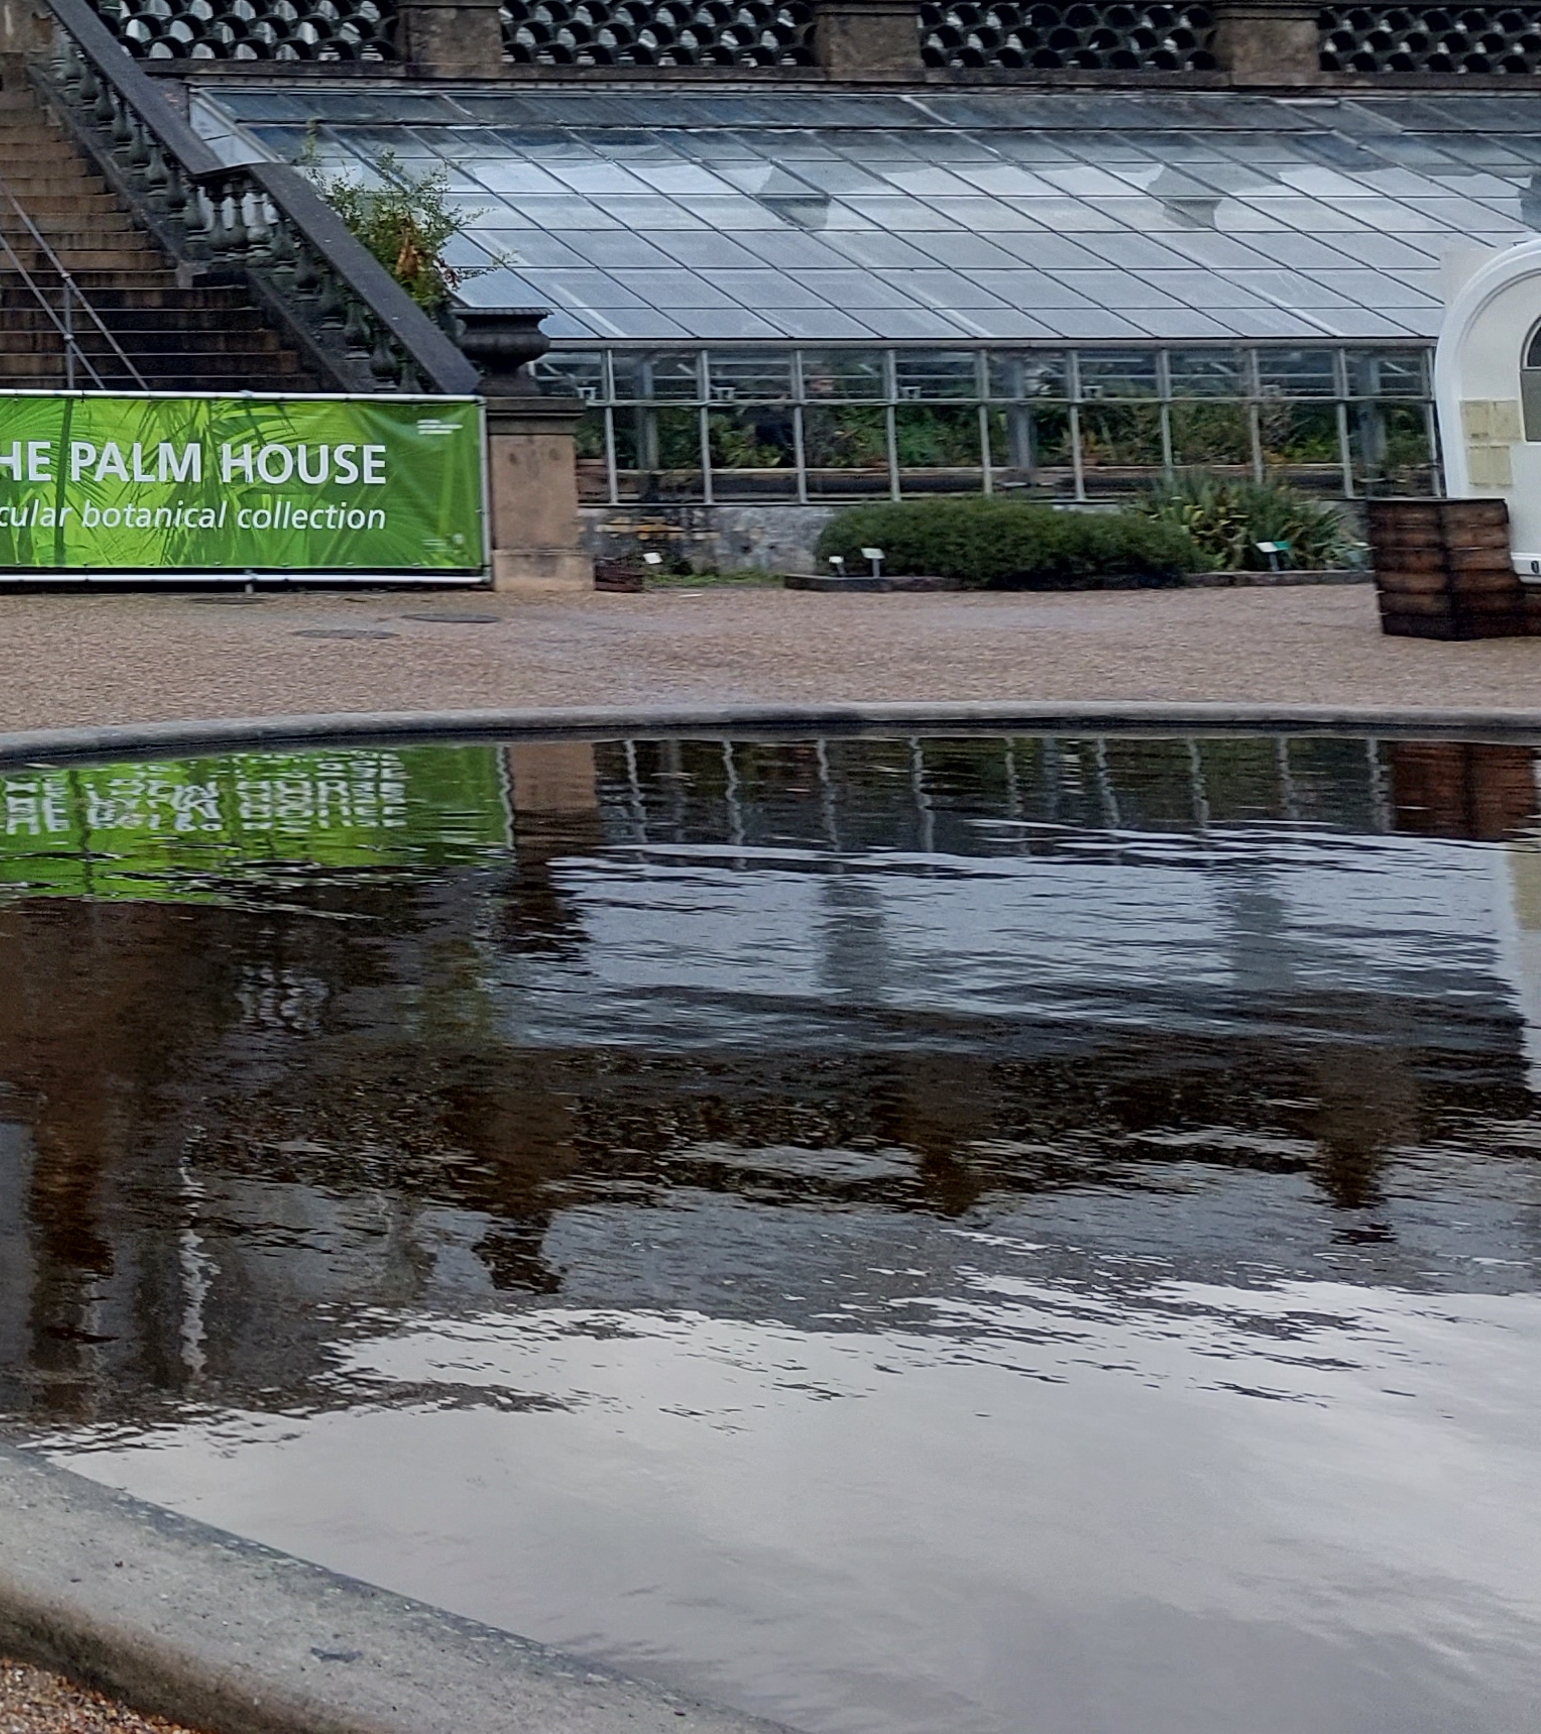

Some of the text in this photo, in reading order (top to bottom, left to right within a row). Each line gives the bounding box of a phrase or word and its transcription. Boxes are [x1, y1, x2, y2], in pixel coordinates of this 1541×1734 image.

[70, 441, 202, 483] PALM
[221, 443, 387, 485] HOUSE
[82, 499, 227, 530] botanical
[237, 500, 386, 530] collection
